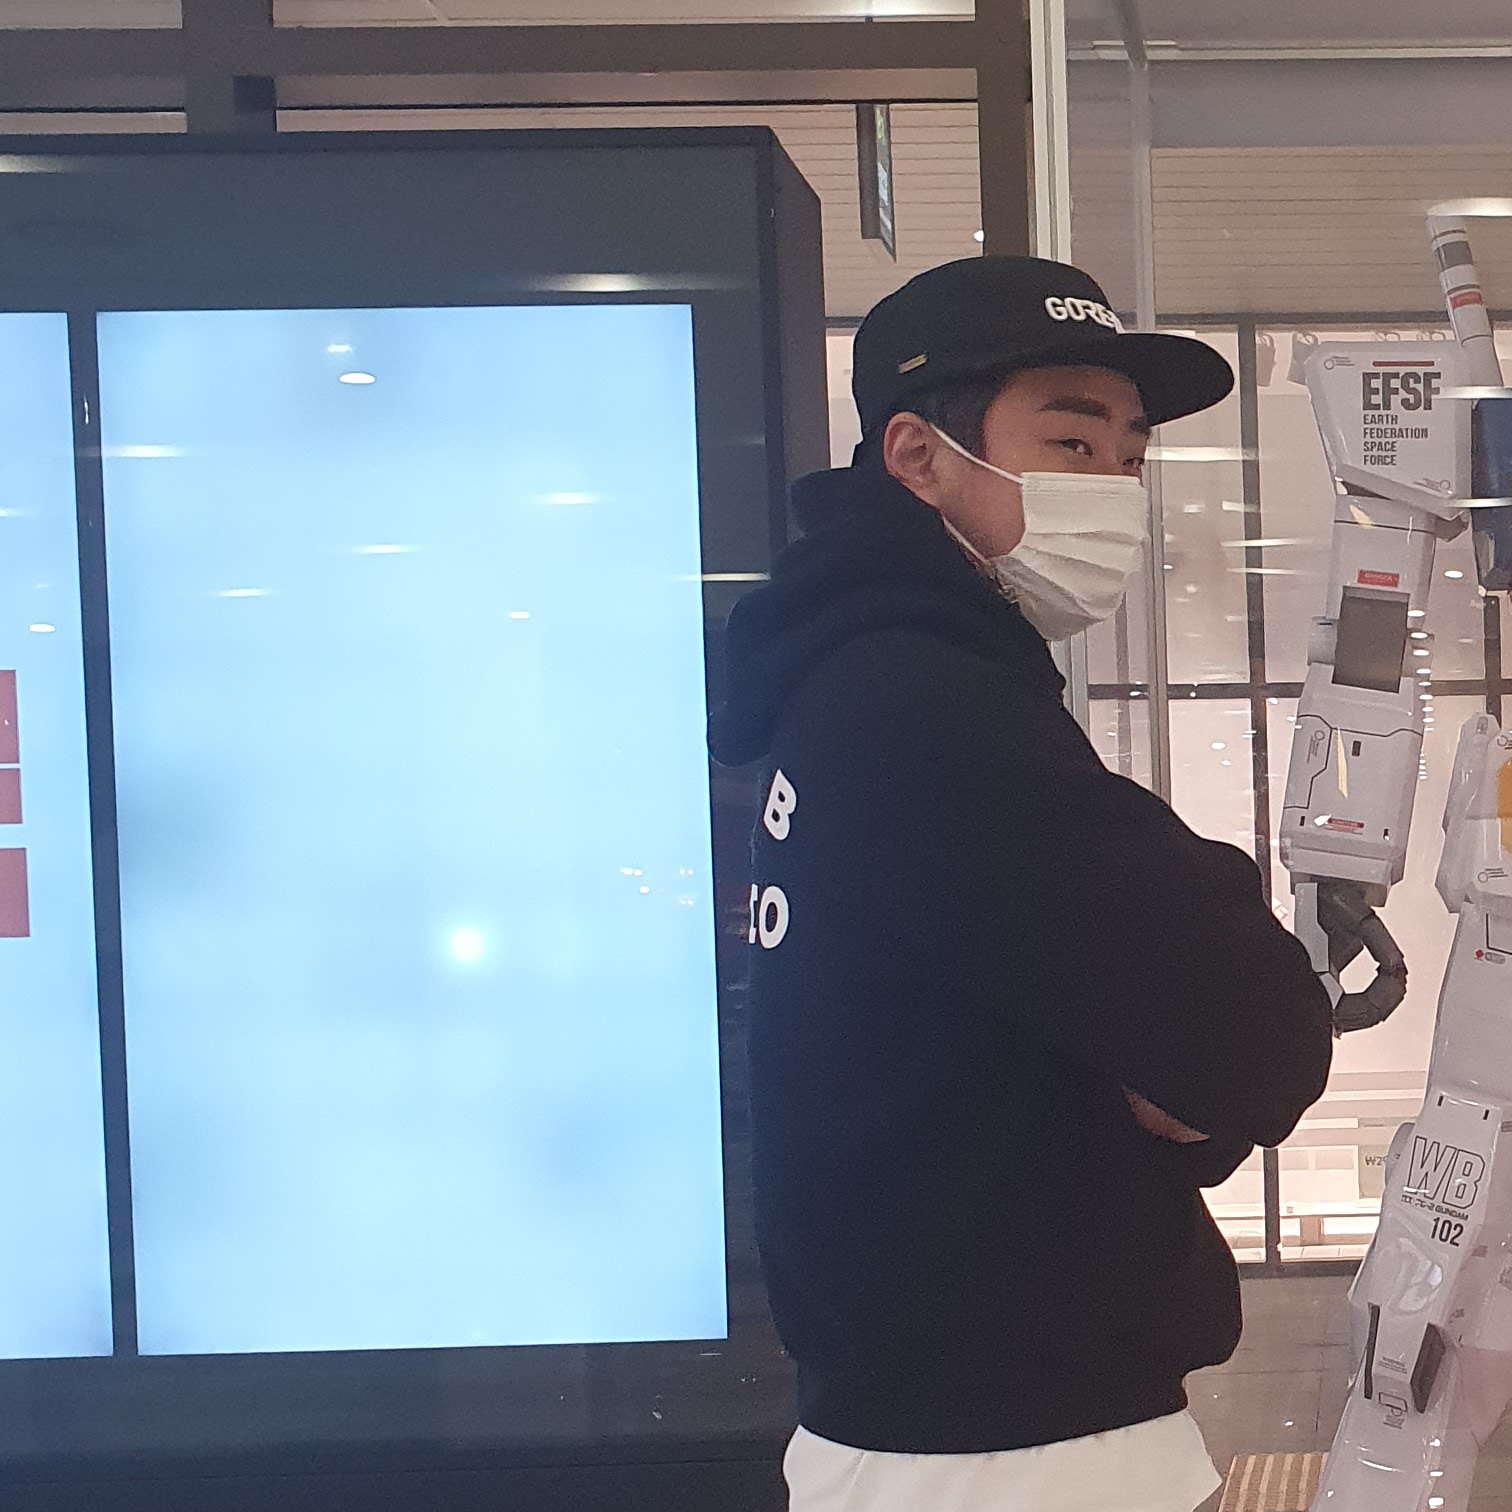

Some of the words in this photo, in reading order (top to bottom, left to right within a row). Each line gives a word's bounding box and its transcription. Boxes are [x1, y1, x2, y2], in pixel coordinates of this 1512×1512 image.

[1362, 372, 1442, 411] EFSF
[1363, 414, 1398, 425] EARTH
[1363, 427, 1429, 439] FEDERATION
[1363, 441, 1398, 452] SPACE
[1363, 454, 1397, 466] FORCE
[1406, 1135, 1485, 1209] WB
[1435, 1205, 1469, 1221] GUNDAM
[1431, 1217, 1464, 1247] 102
